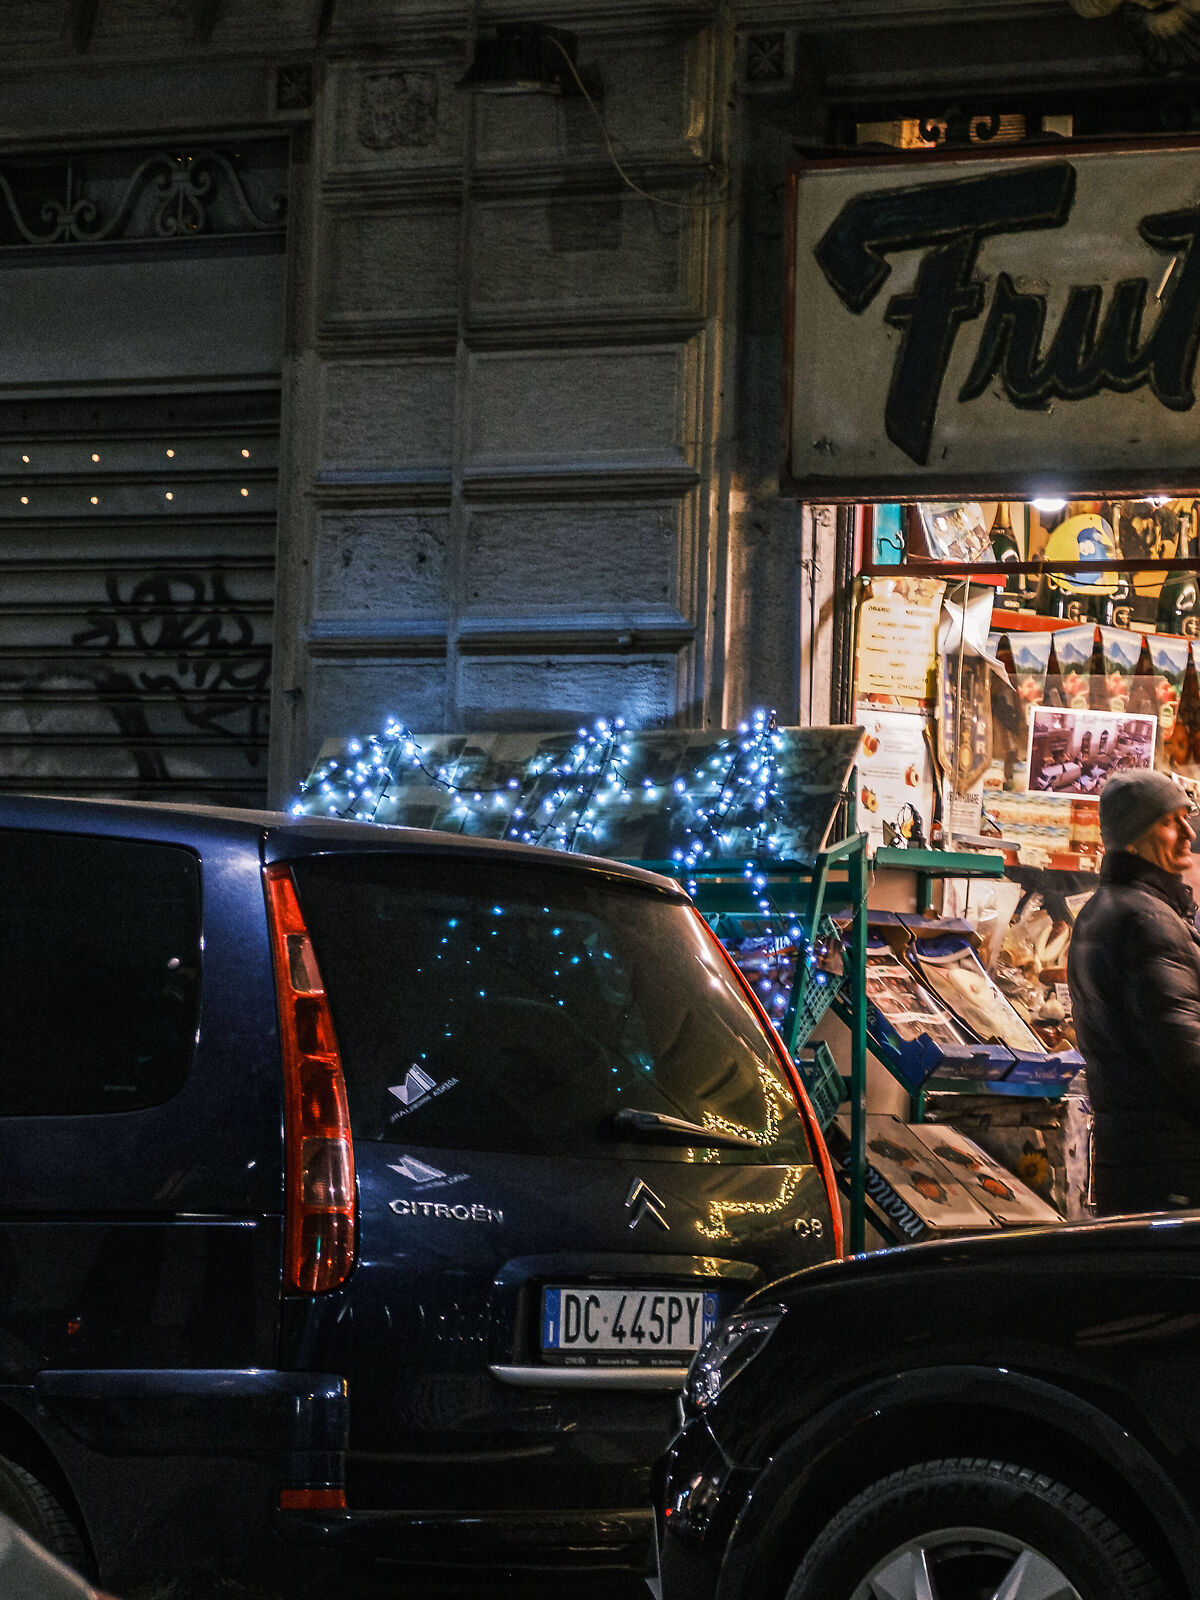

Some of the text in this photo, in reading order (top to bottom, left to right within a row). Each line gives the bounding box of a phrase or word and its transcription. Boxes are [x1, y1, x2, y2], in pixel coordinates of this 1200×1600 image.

[388, 1198, 504, 1224] CITROËN
[793, 1217, 824, 1239] C8
[564, 1294, 601, 1344] DC
[611, 1294, 700, 1346] 445PY
